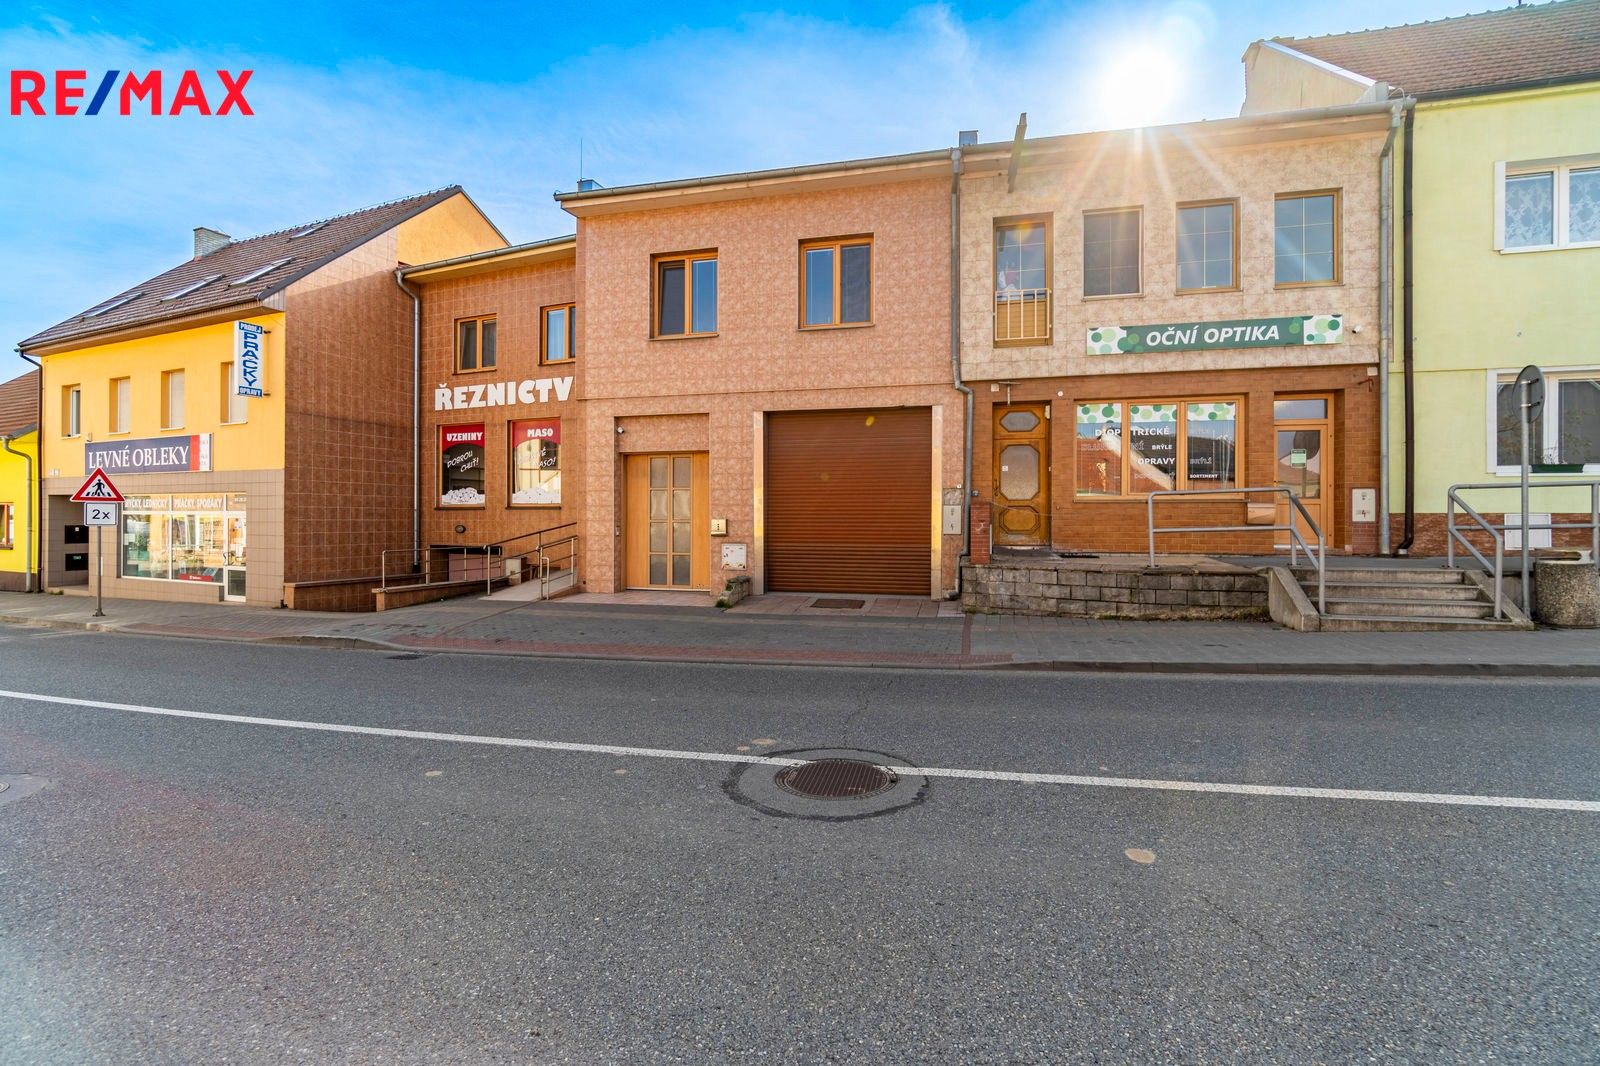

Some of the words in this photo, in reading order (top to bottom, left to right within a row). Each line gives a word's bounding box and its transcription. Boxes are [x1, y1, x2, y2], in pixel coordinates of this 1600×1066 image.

[1146, 325, 1200, 346] OČNÍ
[1204, 325, 1279, 344] OPTIKA
[242, 331, 259, 386] PRAČKY
[435, 376, 574, 411] ŘEZNICTV
[446, 432, 483, 441] UZENINY
[527, 428, 554, 438] MASO
[88, 445, 130, 469] LEVNÉ
[132, 446, 189, 467] OBLEKY
[447, 450, 473, 468] DOBROU
[1137, 457, 1176, 466] OPRAVY
[92, 509, 111, 520] 2x
